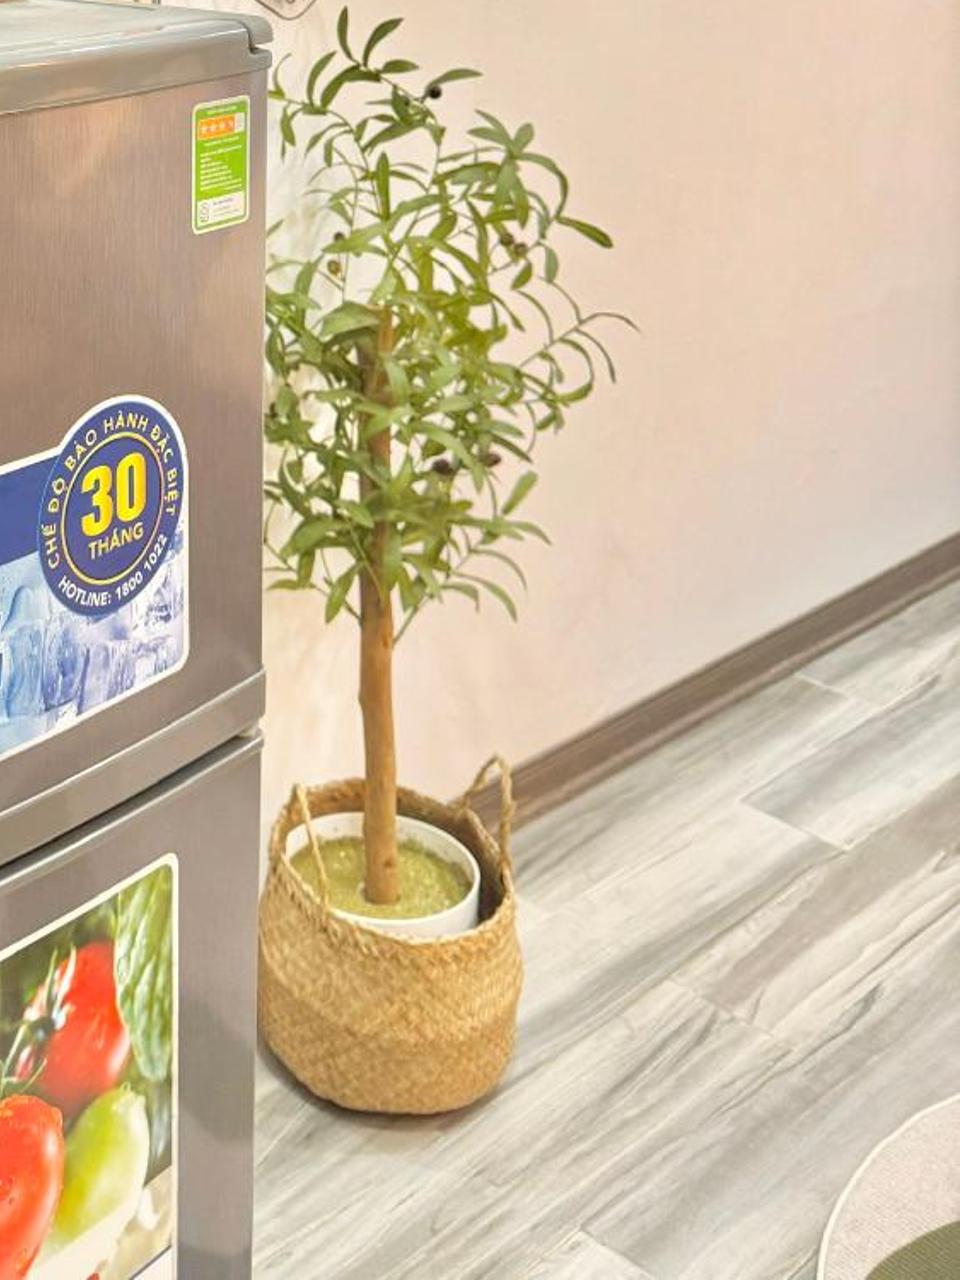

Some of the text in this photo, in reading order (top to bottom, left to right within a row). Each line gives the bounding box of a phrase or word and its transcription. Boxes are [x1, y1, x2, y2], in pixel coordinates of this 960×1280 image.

[81, 452, 147, 537] 30
[58, 534, 167, 606] HOTLINE: 1800 1022
[88, 522, 144, 560] THÁNG
